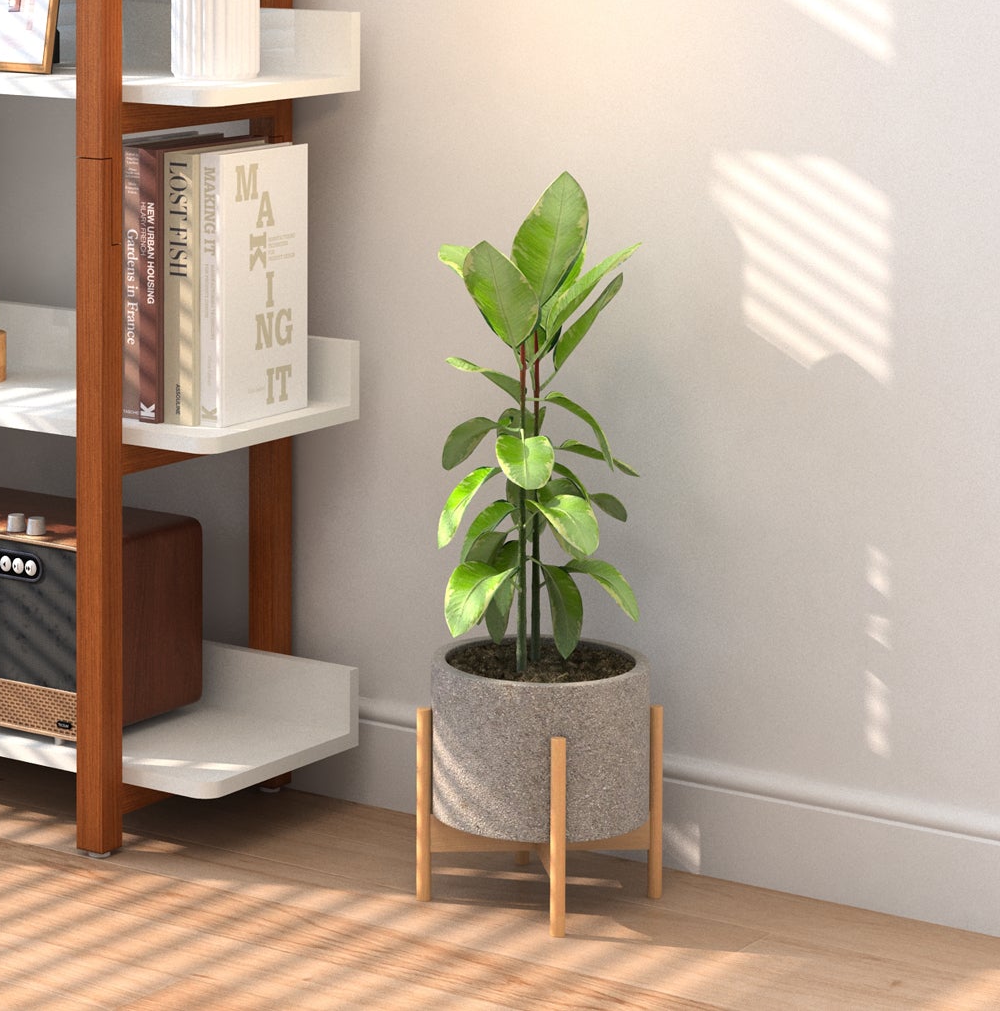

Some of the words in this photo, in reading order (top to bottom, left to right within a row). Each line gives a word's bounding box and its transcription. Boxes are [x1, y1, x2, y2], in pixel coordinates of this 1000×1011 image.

[169, 161, 188, 221] LOST
[204, 166, 216, 235] MAKING
[146, 202, 155, 225] NEW
[126, 228, 139, 282] Gardens
[146, 226, 155, 260] URBAN
[169, 227, 188, 277] FISH
[204, 239, 216, 257] IT
[126, 285, 139, 297] in
[146, 261, 155, 305] HOUSING
[126, 301, 139, 345] France
